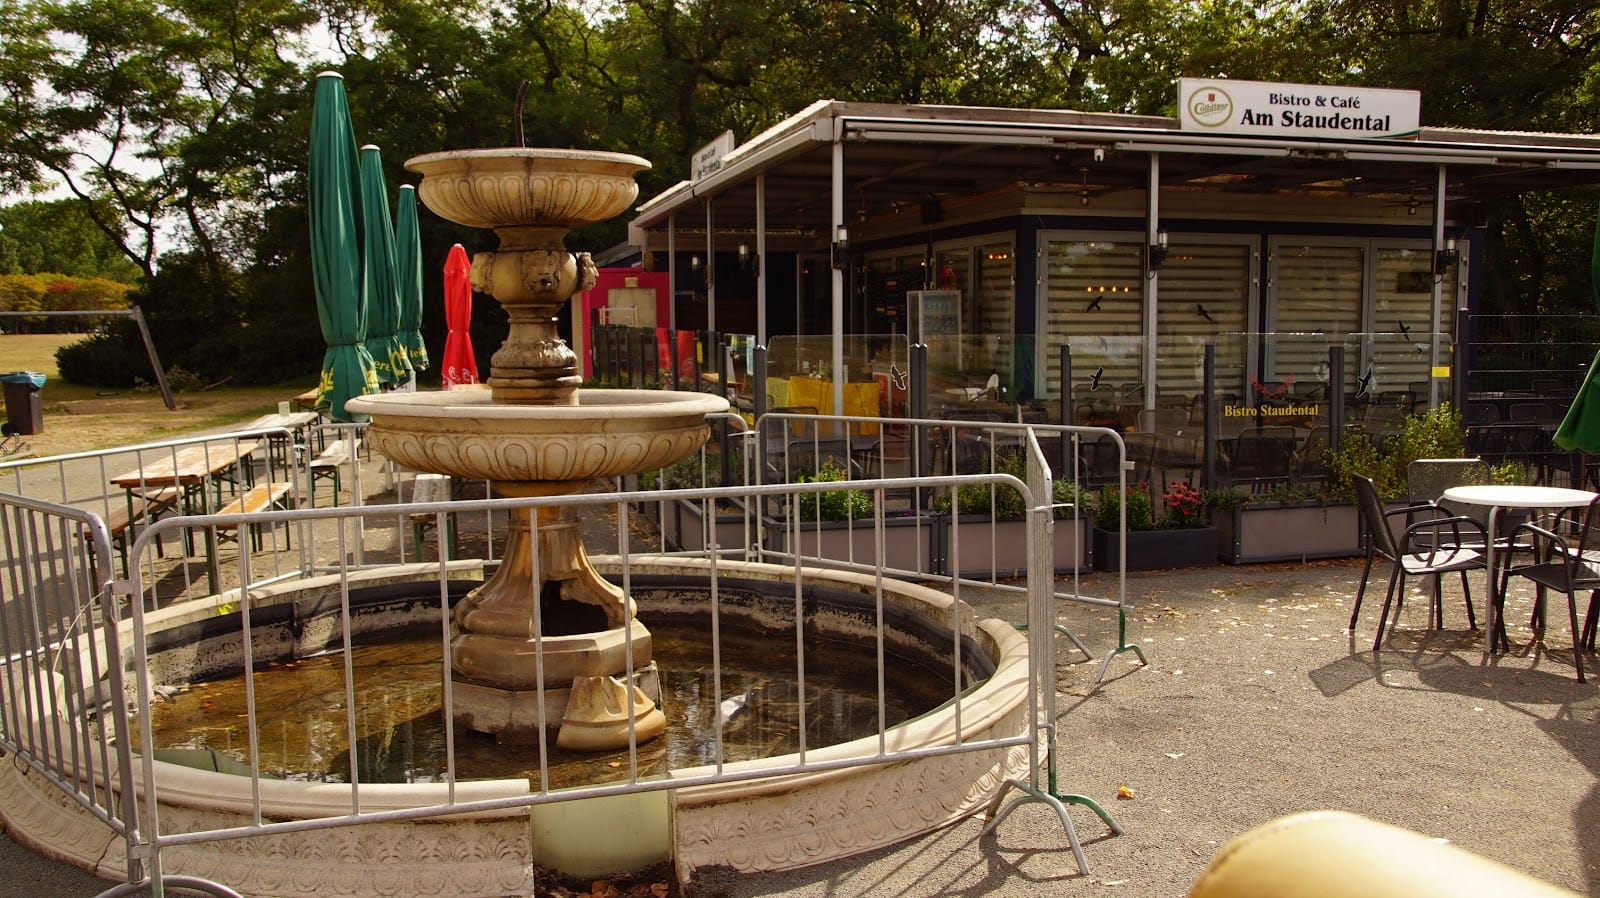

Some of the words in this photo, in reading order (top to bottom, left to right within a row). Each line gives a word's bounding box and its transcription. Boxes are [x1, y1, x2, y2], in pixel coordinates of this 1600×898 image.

[1269, 93, 1310, 107] Bistro
[1315, 96, 1326, 107] &
[1331, 96, 1361, 109] Café
[1241, 109, 1273, 126] Am
[1281, 111, 1390, 131] Staudental
[1224, 405, 1258, 416] Bistro
[1260, 404, 1319, 416] Staudental
